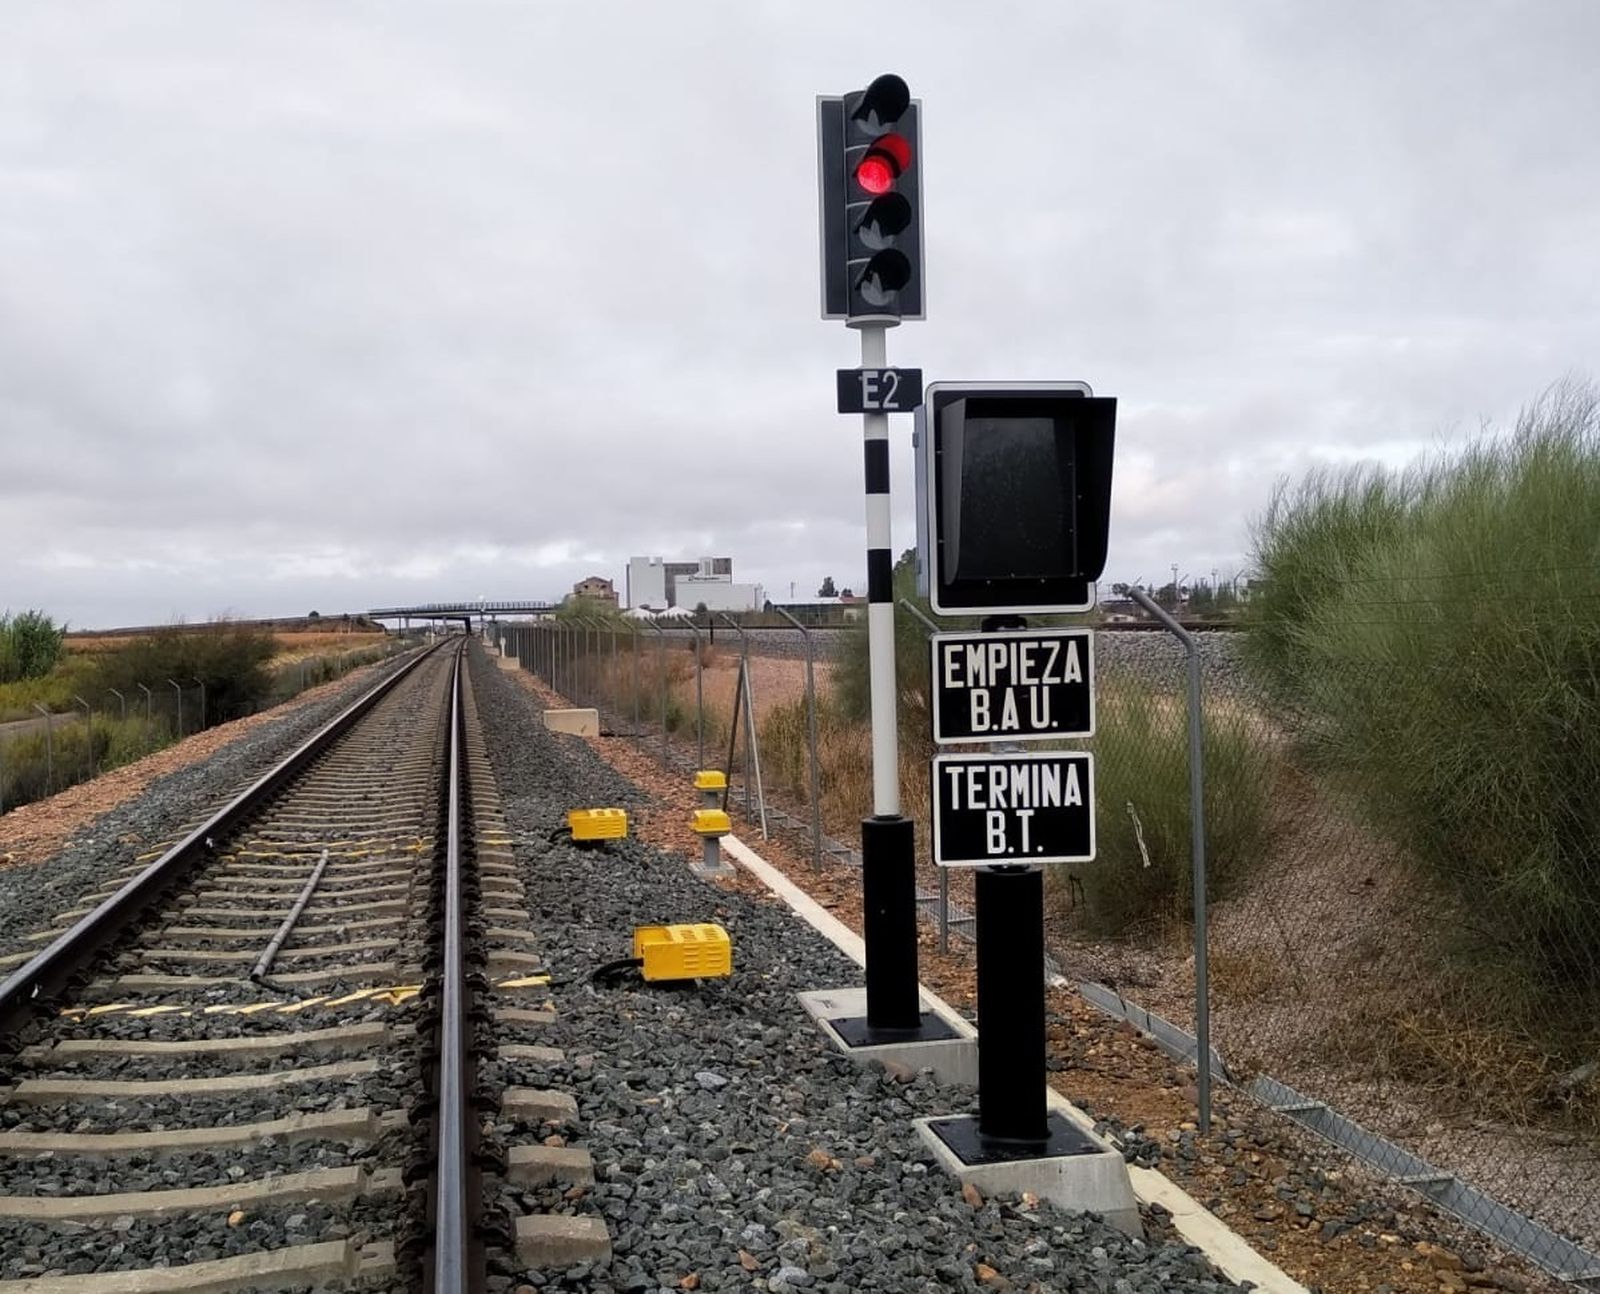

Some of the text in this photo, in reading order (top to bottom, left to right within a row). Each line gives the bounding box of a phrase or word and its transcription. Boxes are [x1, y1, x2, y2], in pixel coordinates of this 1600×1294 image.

[862, 371, 898, 408] E2
[944, 640, 1082, 688] EMPIEZA
[945, 763, 1082, 810] TERMINA
[986, 809, 1043, 854] B.T.
